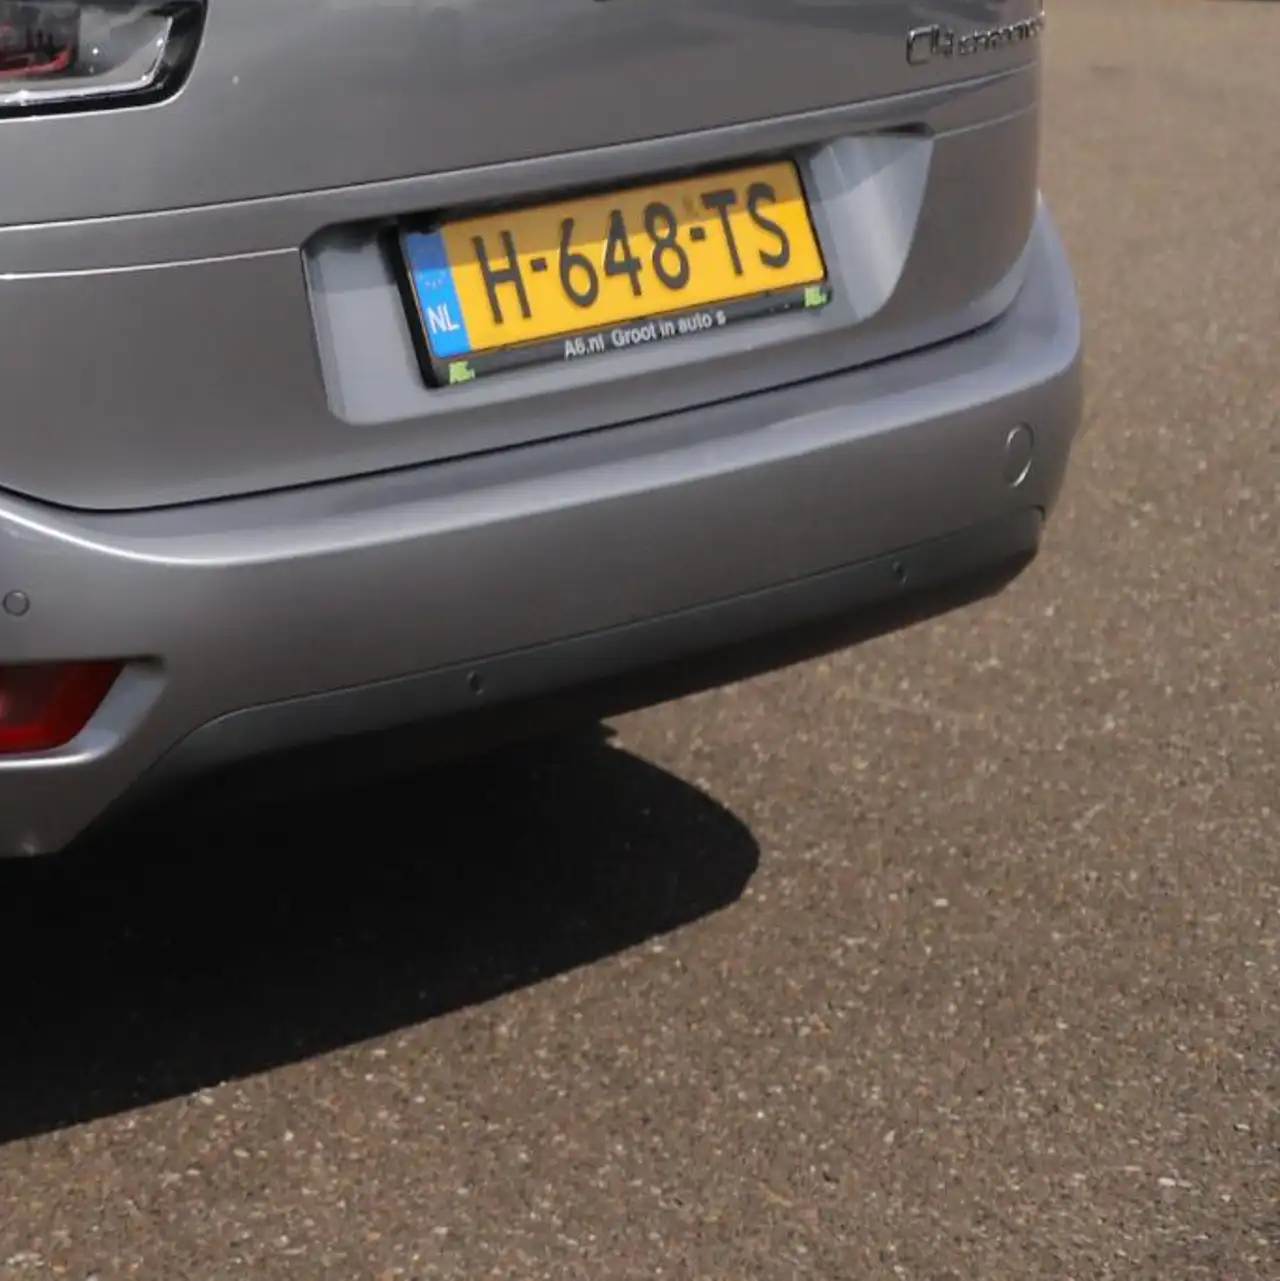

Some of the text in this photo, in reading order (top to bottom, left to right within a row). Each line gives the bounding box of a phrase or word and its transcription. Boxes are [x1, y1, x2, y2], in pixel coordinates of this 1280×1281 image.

[472, 183, 790, 324] H-648-TS
[425, 303, 460, 335] NL
[565, 334, 604, 358] A6.nl
[612, 323, 656, 347] Groot
[660, 321, 675, 337] in
